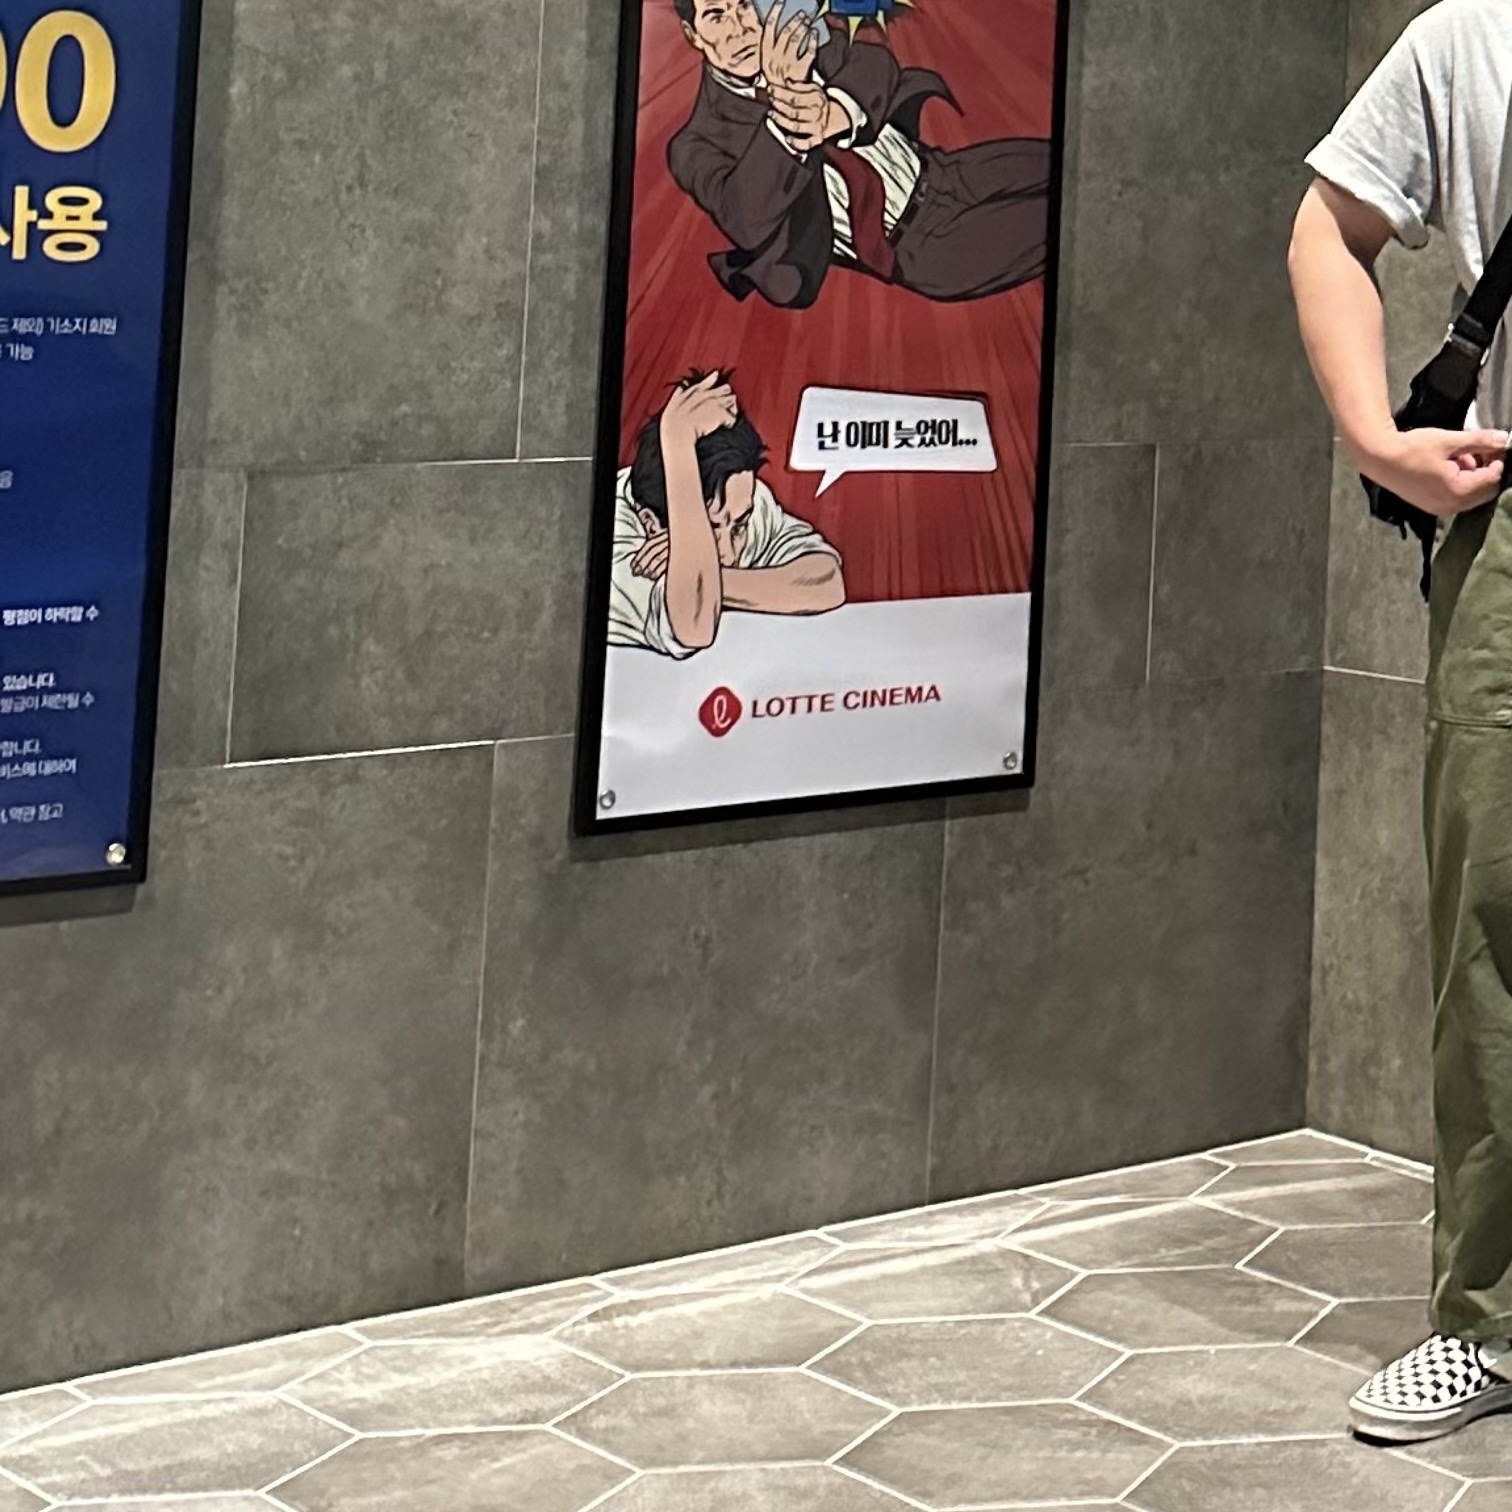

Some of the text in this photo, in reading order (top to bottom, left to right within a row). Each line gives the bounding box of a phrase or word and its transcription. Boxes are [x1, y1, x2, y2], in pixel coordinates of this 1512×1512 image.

[817, 418, 978, 451] 난 이미 늦었어...
[85, 605, 99, 621] 수
[751, 685, 941, 719] LOTTE CINEMA
